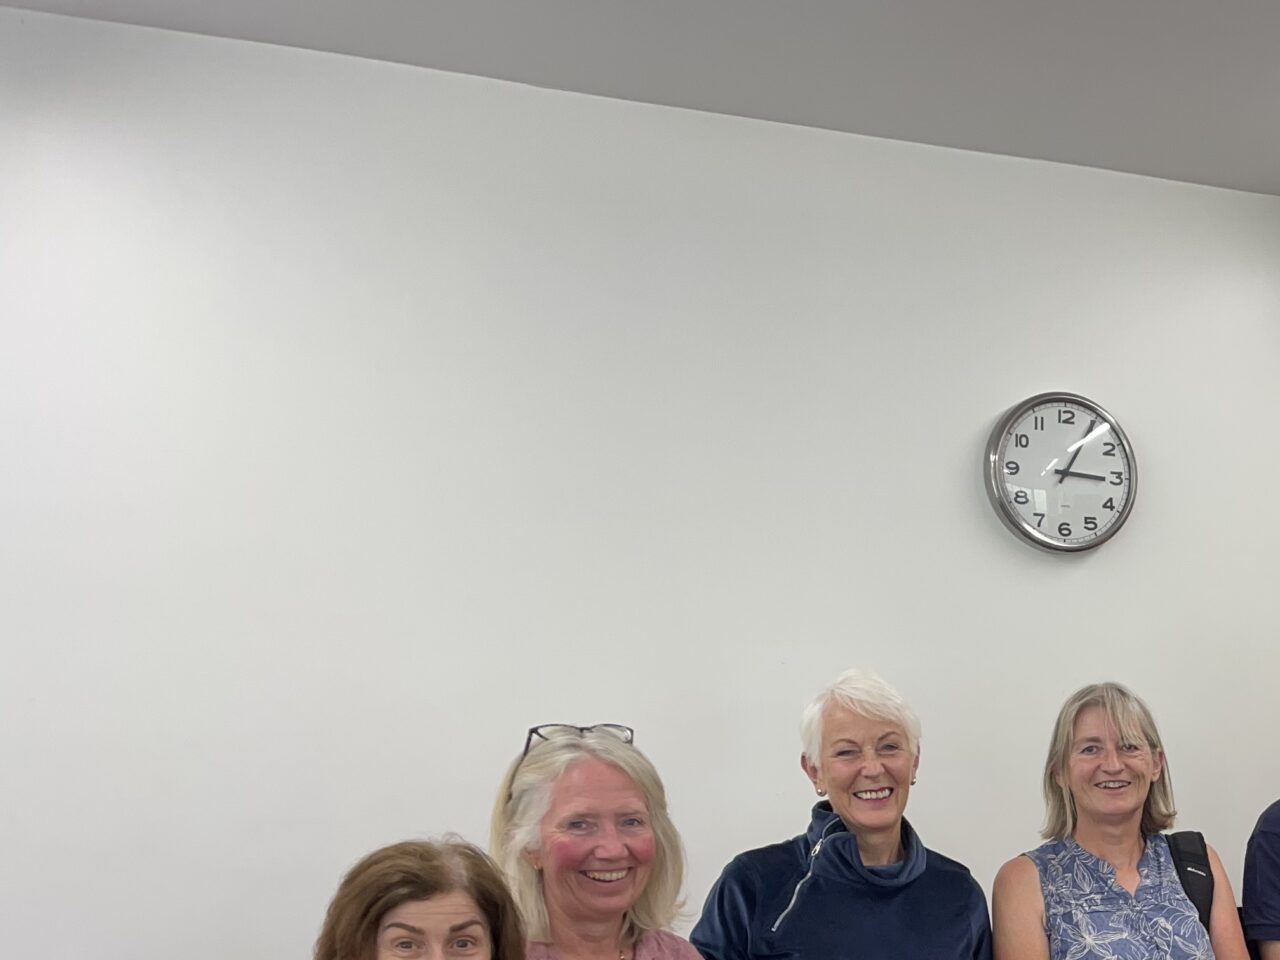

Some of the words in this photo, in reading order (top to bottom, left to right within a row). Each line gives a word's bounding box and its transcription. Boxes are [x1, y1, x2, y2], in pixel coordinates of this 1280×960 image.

[1034, 416, 1044, 431] 11
[1058, 409, 1075, 425] 12
[1015, 433, 1029, 448] 10
[1102, 442, 1116, 456] 2
[1005, 461, 1019, 475] 9
[1109, 471, 1123, 486] 3
[1014, 490, 1029, 505] 8
[1102, 497, 1115, 511] 4
[1033, 513, 1045, 528] 7
[1083, 516, 1097, 531] 5
[1058, 522, 1072, 537] 6
